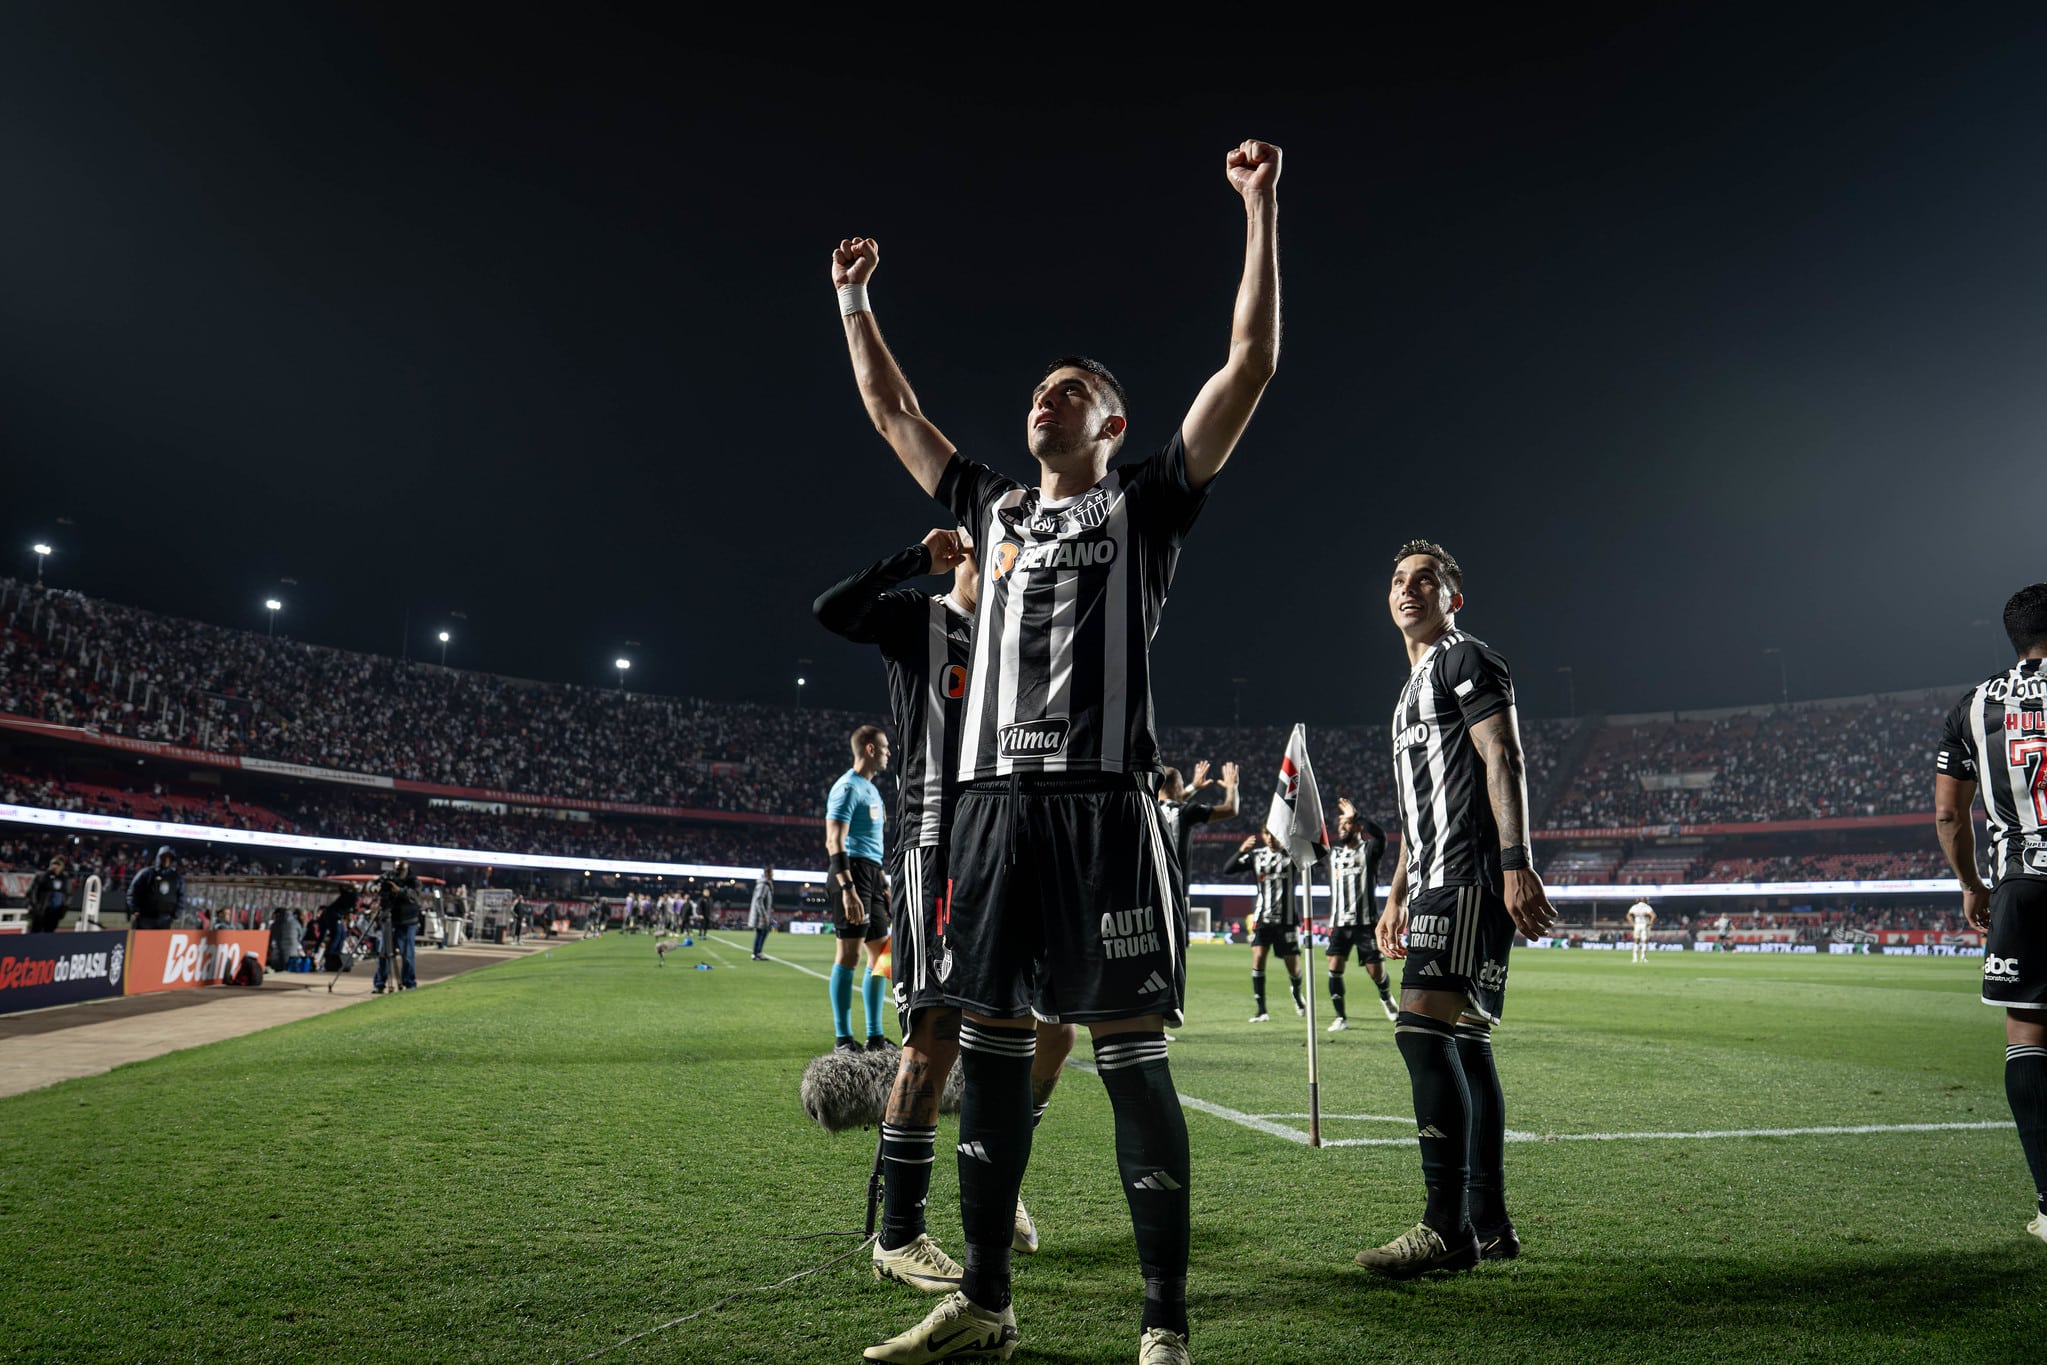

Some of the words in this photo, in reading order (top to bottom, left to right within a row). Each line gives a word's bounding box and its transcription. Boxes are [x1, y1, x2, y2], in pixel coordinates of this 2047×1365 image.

[1076, 493, 1104, 513] CAM
[1018, 540, 1115, 570] BETANO
[1000, 728, 1060, 751] Vilma
[1101, 906, 1154, 938] AUTO
[1410, 915, 1449, 934] AUTO
[1102, 932, 1160, 959] TRUCK
[1410, 933, 1448, 950] TRUCK
[0, 956, 55, 990] Betano
[54, 955, 70, 982] do
[69, 953, 107, 980] BRASIL
[1985, 953, 2019, 975] abc
